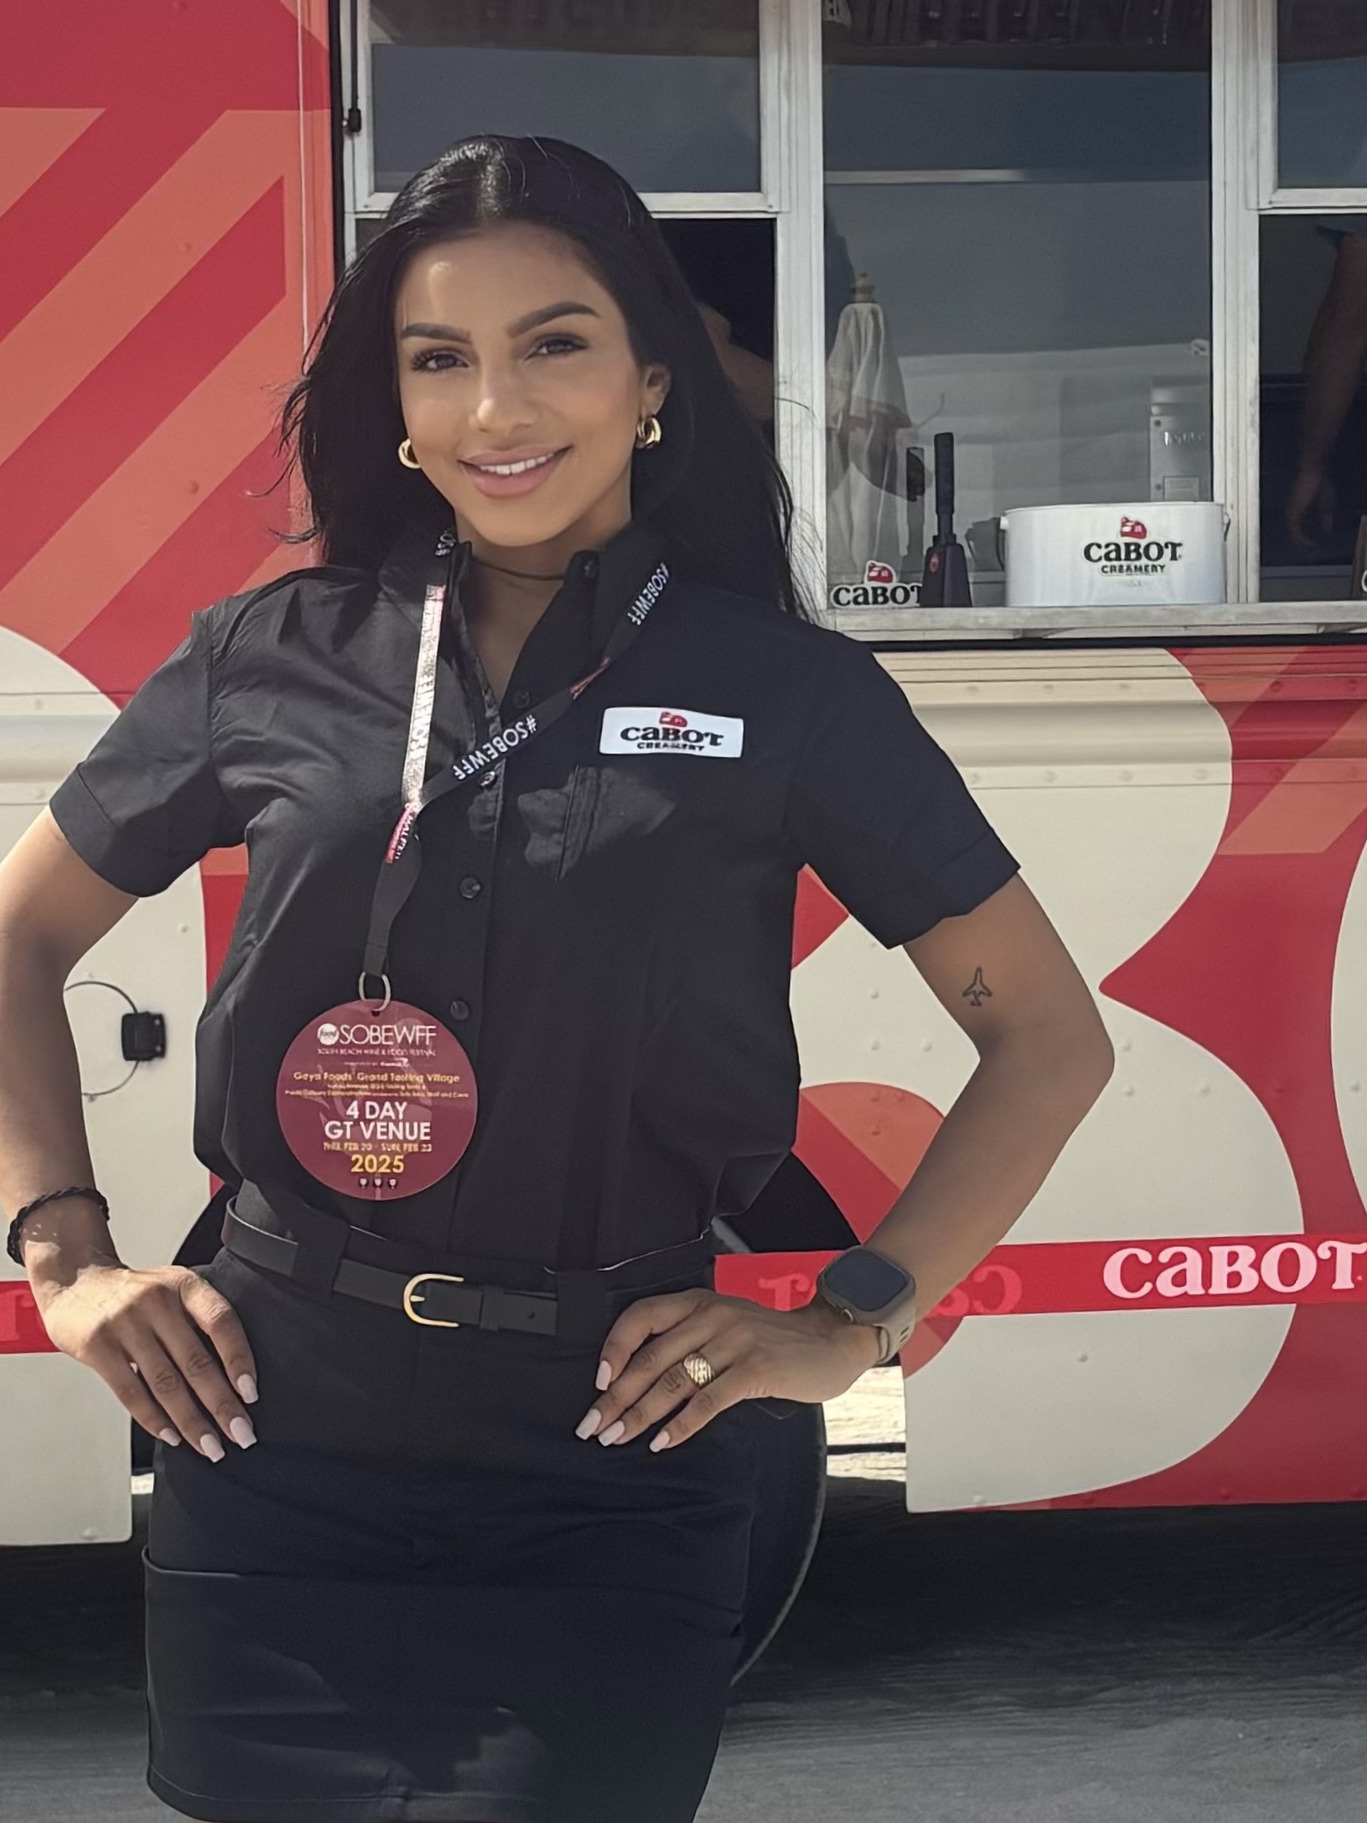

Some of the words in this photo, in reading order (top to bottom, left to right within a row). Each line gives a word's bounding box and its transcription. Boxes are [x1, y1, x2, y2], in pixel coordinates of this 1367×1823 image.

[1100, 563, 1166, 575] CREAMERY
[452, 713, 538, 781] #SOBEWFF
[339, 1024, 437, 1045] SOBEWFF
[427, 1073, 460, 1084] Village
[346, 1100, 359, 1119] 4
[365, 1101, 408, 1120] DAY
[324, 1121, 354, 1139] GT
[360, 1121, 431, 1141] VENUE
[351, 1154, 405, 1173] 2025
